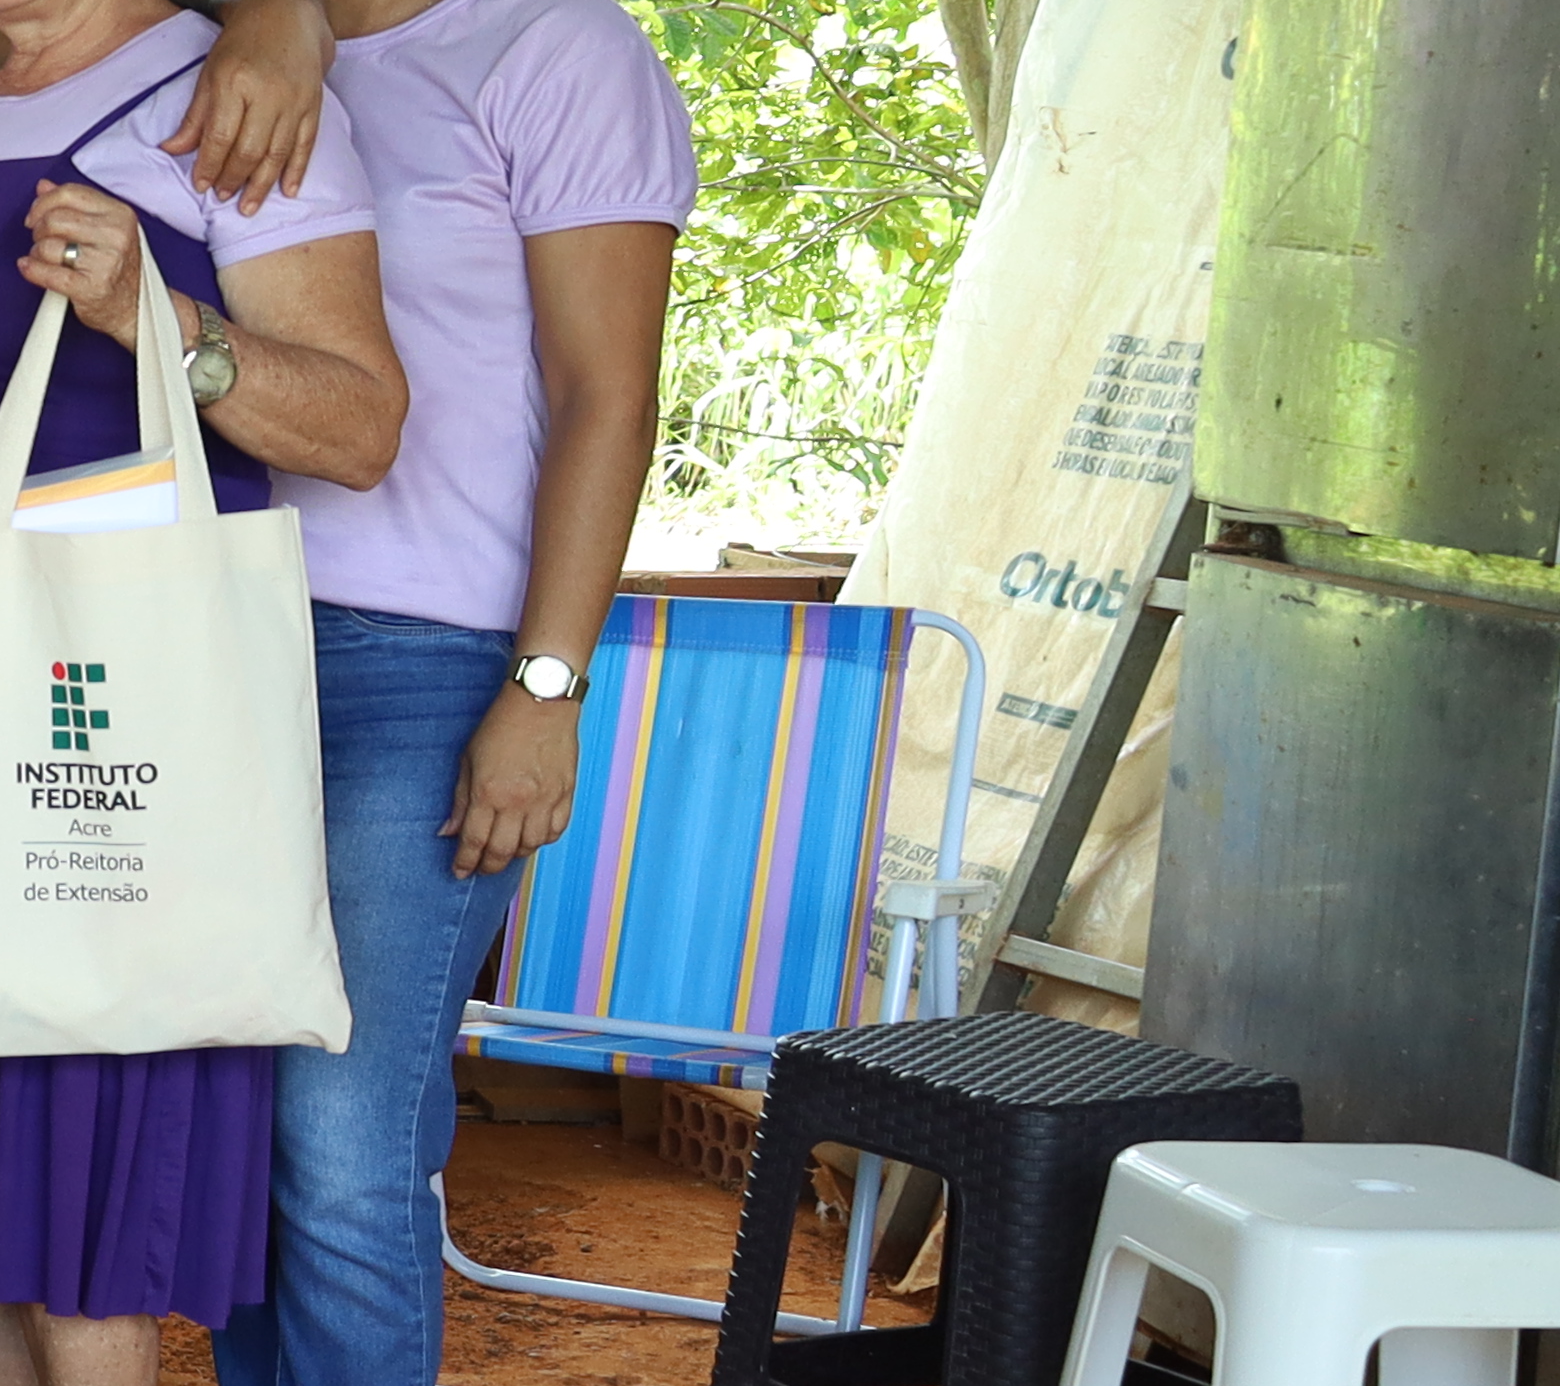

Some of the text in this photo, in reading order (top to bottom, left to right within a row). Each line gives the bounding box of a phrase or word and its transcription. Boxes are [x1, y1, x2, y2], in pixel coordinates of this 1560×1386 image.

[999, 551, 1131, 619] Ortob
[16, 762, 158, 786] INSTITUTO
[31, 788, 147, 811] FEDERAL
[68, 818, 113, 837] Acre
[25, 849, 144, 872] Pró-Reitoria
[23, 882, 149, 902] de Extensão
